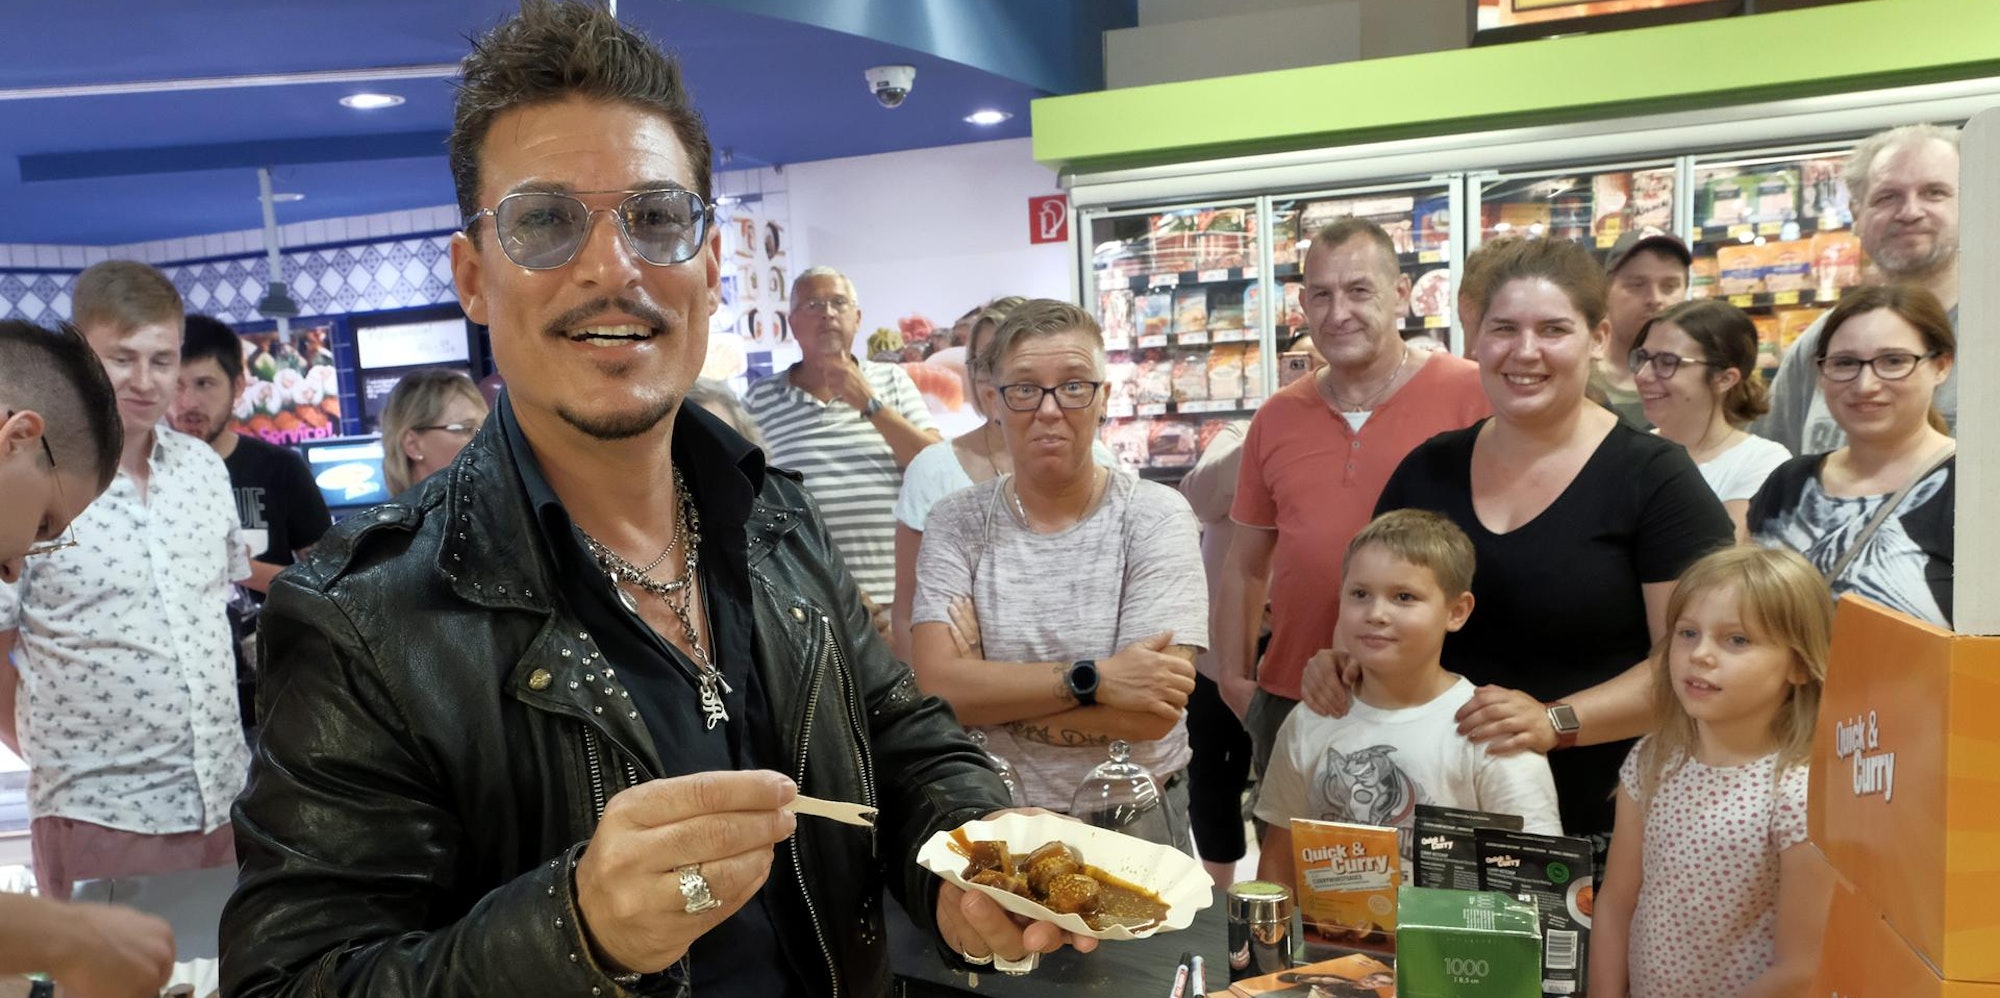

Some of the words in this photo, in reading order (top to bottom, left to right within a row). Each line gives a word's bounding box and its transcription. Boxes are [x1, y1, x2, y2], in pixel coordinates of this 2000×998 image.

[1836, 714, 1865, 760] Quick
[1868, 710, 1879, 749] &
[1853, 750, 1894, 802] Curry
[1302, 844, 1347, 864] Quick
[1352, 841, 1366, 856] &
[1331, 855, 1390, 874] Curry
[1444, 957, 1490, 977] 1000
